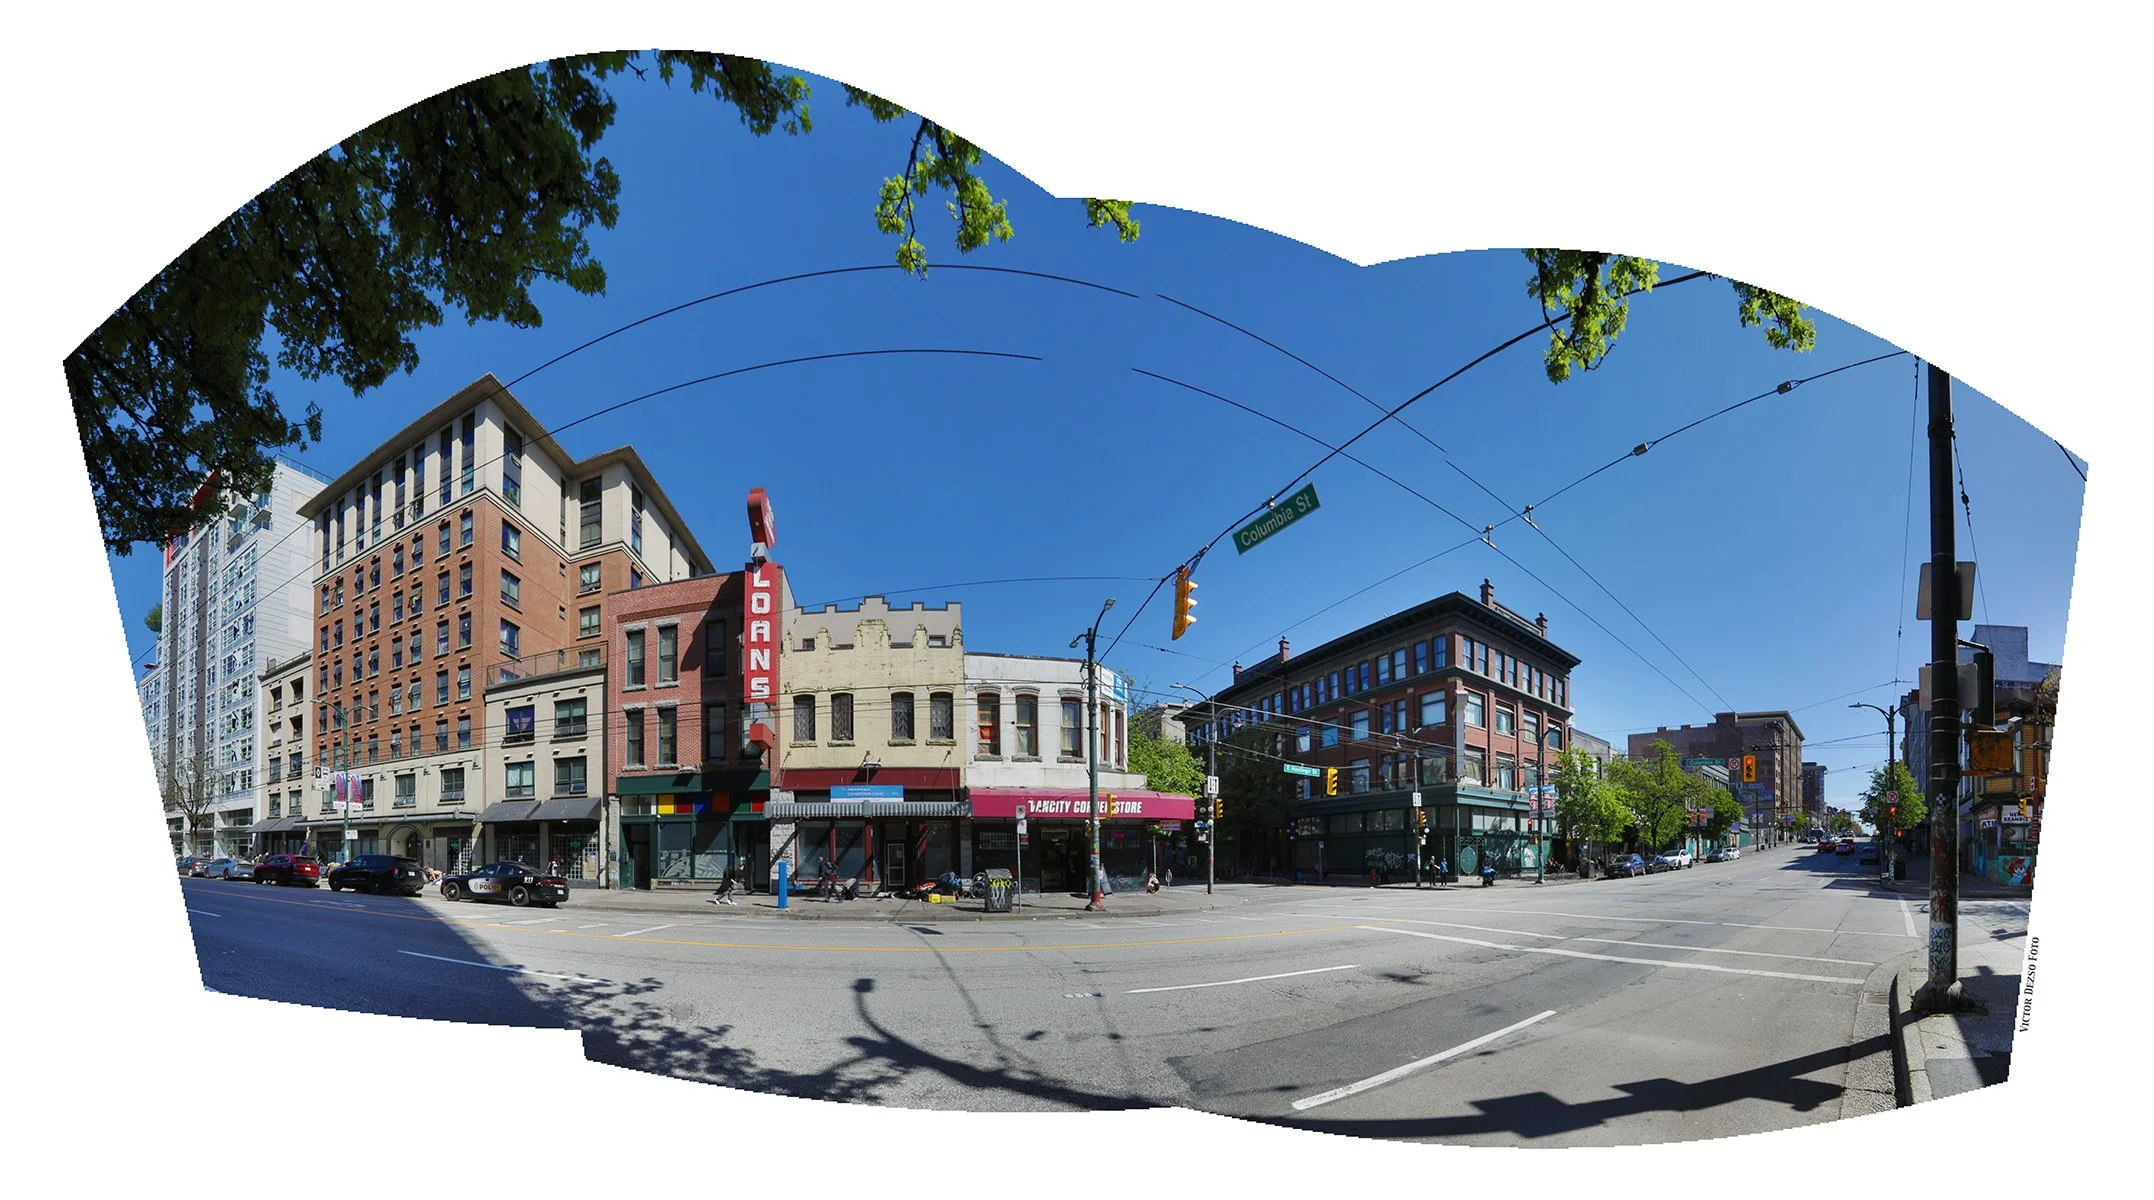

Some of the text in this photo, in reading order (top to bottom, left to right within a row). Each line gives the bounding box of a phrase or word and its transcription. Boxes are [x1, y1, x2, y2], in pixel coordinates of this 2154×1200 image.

[1240, 493, 1312, 546] Columbia St
[750, 568, 771, 700] LOANS
[1073, 801, 1110, 813] CORE
[1115, 801, 1142, 813] STORE
